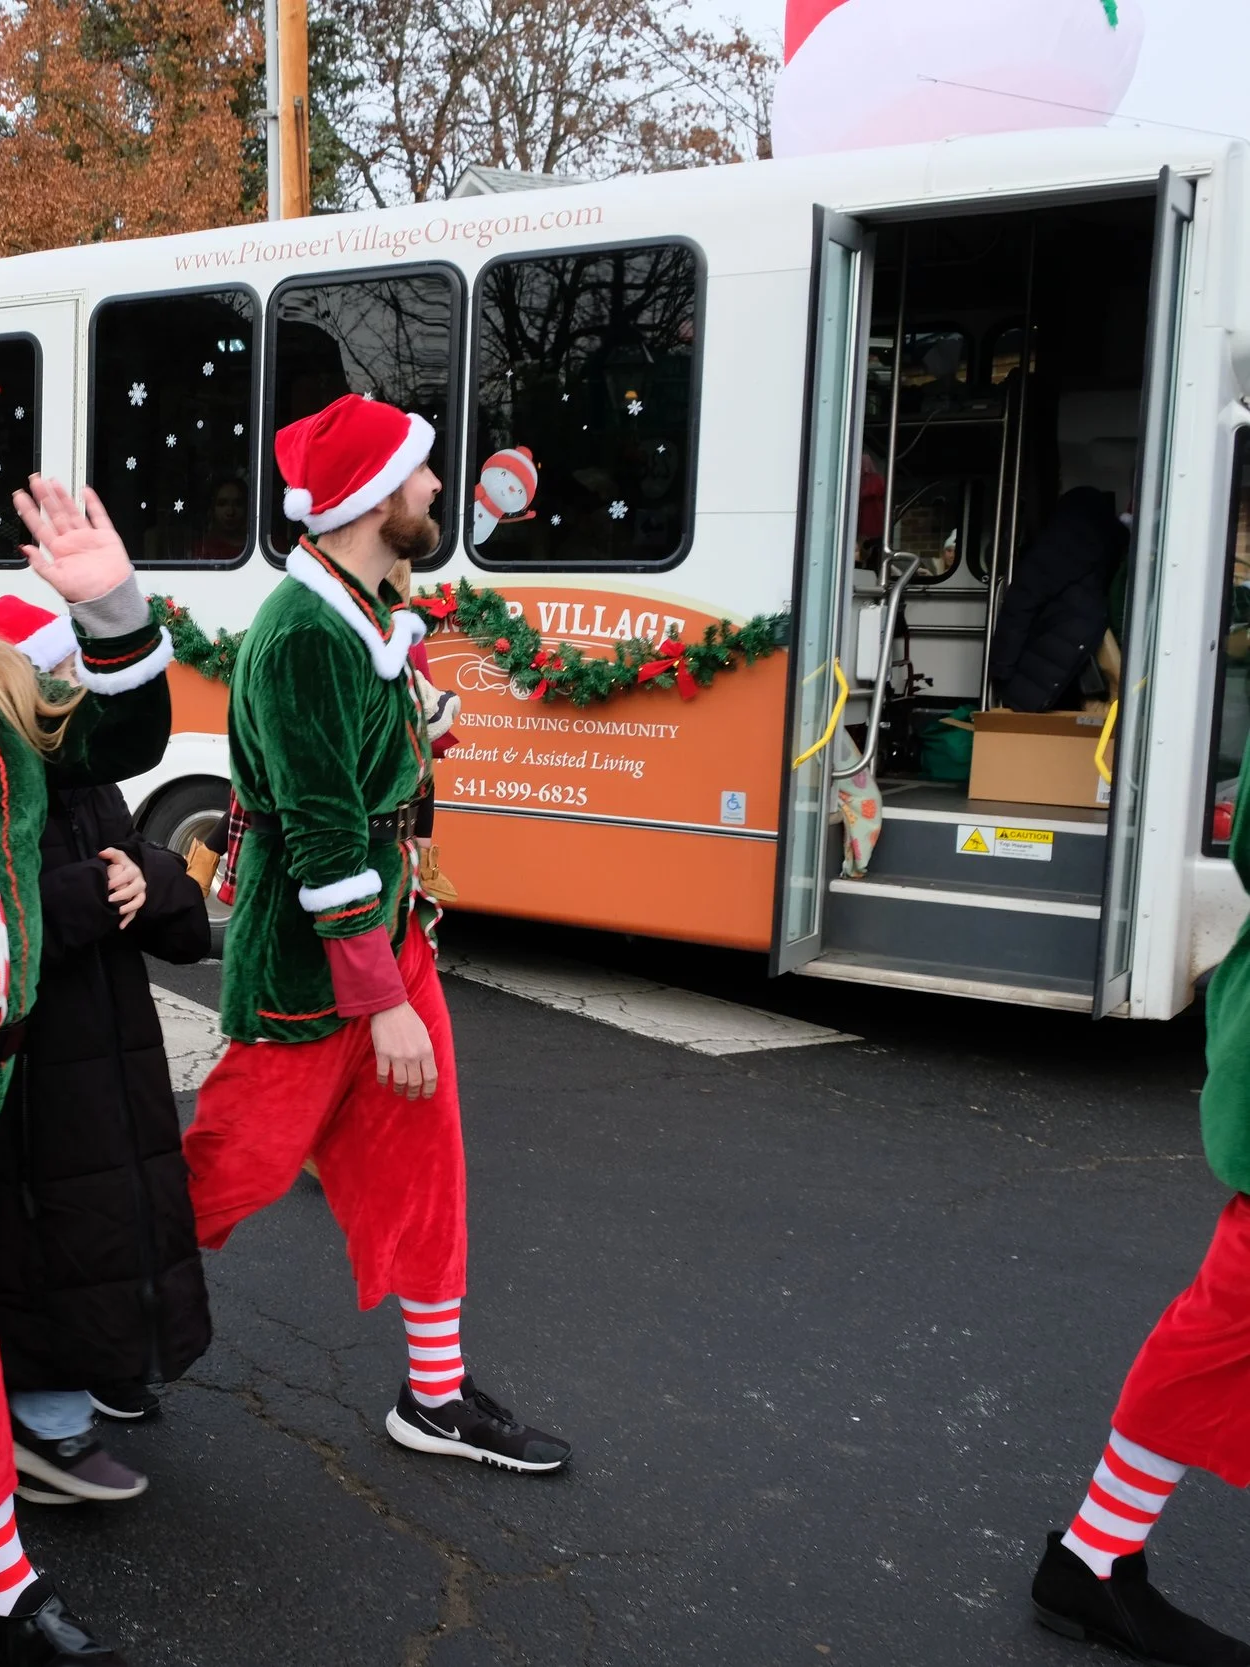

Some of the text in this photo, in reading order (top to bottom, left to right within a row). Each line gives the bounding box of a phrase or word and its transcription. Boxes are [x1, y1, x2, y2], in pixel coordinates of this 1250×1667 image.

[174, 205, 604, 271] www.PioneerVillageOregon.com
[459, 713, 680, 739] SENIOR LIVING COMMUNITY
[503, 747, 519, 763] &
[521, 748, 586, 769] Assisted
[590, 752, 646, 779] Living
[453, 777, 589, 806] 541-899-6825
[1009, 830, 1050, 841] CAUTION
